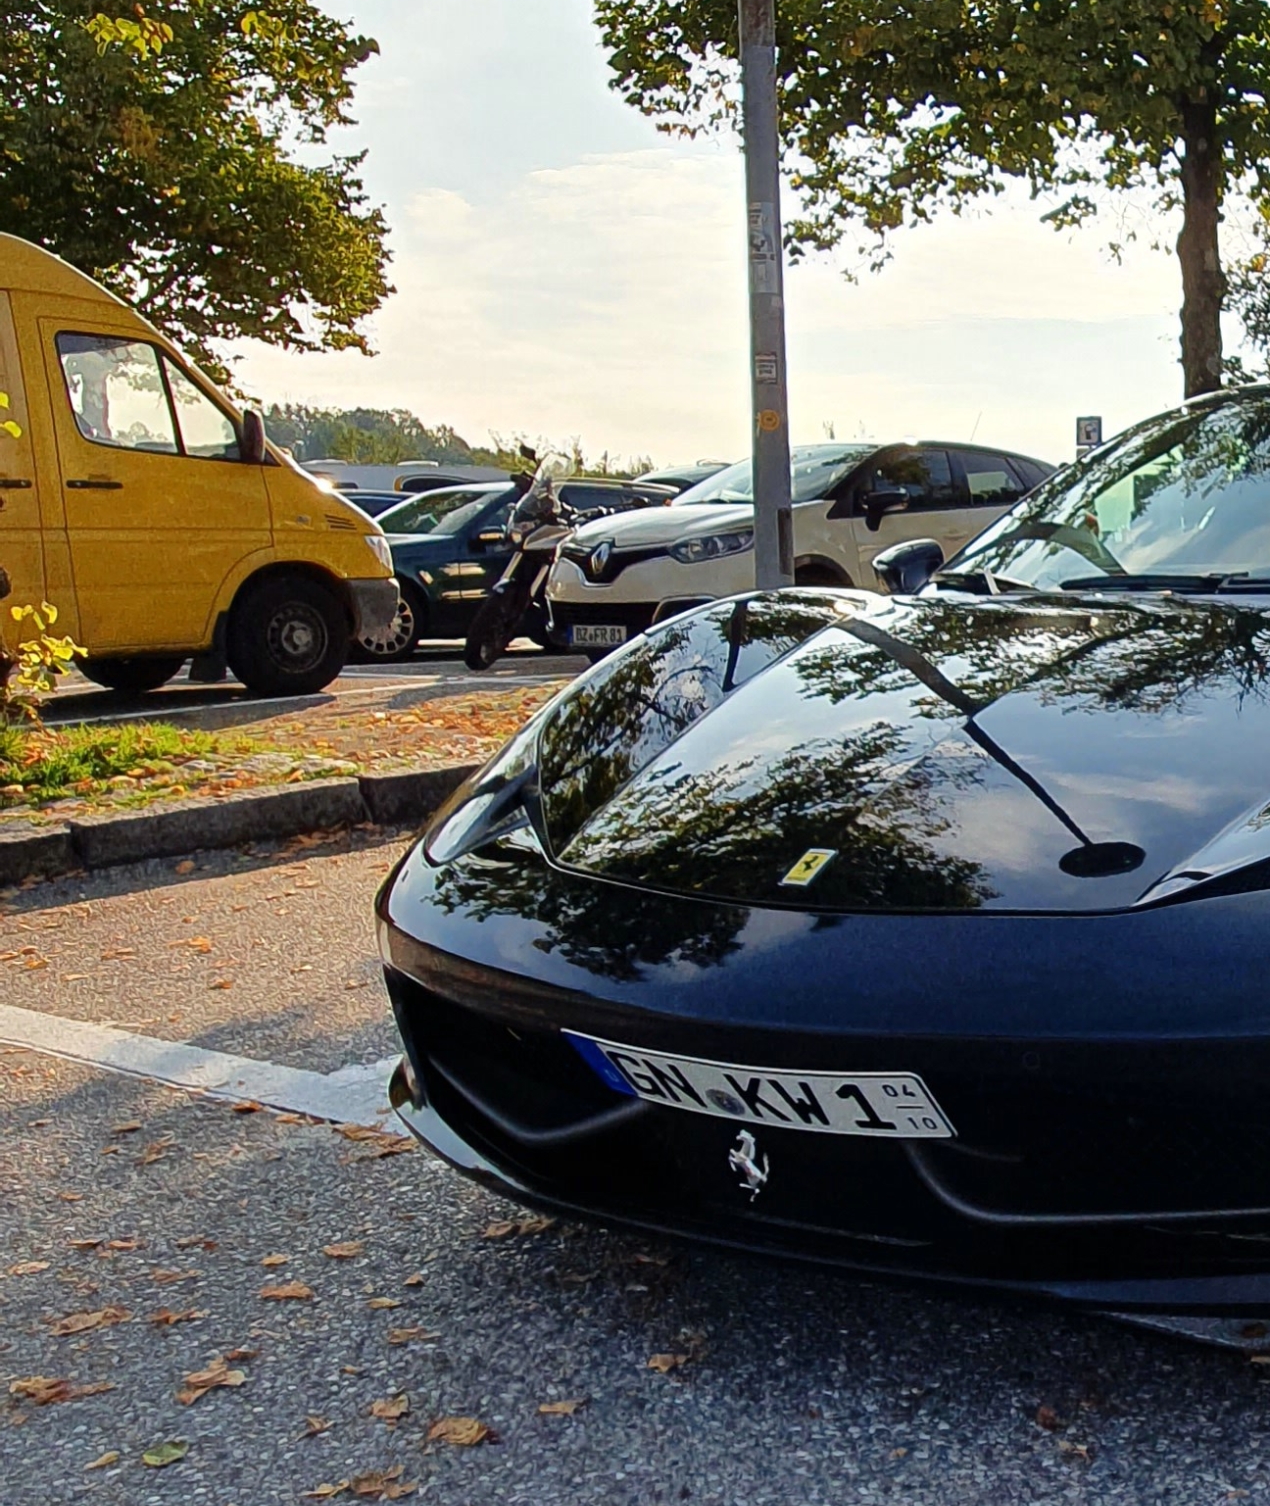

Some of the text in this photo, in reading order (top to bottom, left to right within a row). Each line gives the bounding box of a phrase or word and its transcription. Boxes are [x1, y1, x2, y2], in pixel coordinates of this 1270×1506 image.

[605, 1050, 897, 1130] GN KW 1
